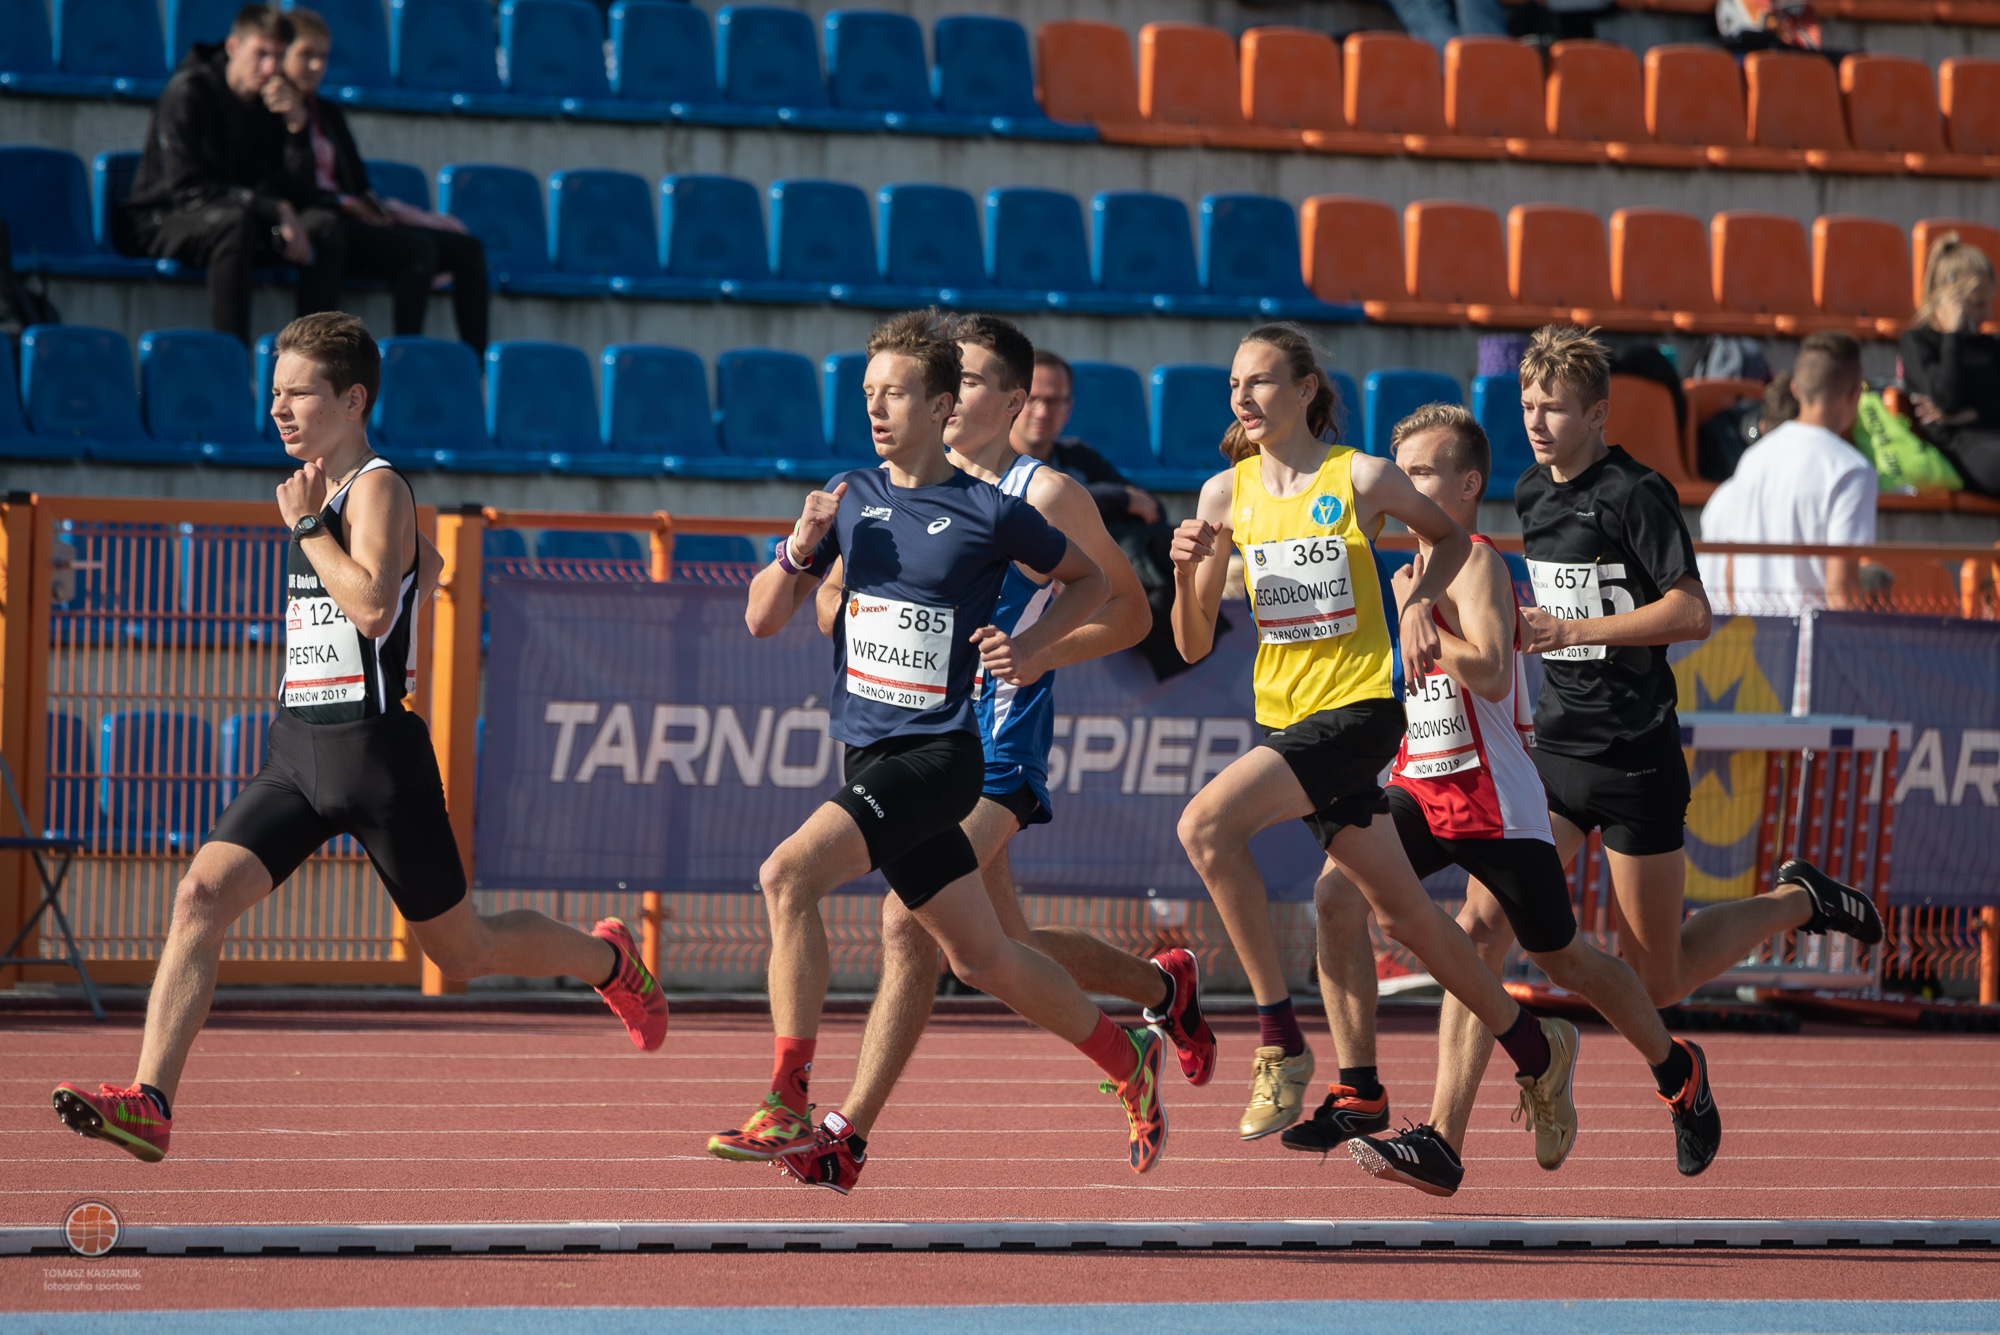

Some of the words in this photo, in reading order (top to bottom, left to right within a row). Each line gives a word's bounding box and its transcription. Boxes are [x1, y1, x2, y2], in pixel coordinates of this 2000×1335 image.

[1293, 540, 1340, 566] 365
[1554, 568, 1591, 589] 657
[309, 602, 348, 626] 124
[898, 607, 947, 634] 585
[1269, 625, 1311, 641] TARNÓW
[1313, 623, 1340, 637] 2019
[289, 644, 340, 666] PESTKA
[852, 638, 939, 671] WRZAŁEK
[1567, 647, 1590, 658] 2019
[287, 689, 319, 704] TARNÓW
[322, 688, 348, 701] 2019
[858, 683, 896, 701] TARNÓW
[898, 693, 926, 706] 2019
[1423, 678, 1457, 702] 151
[1406, 714, 1467, 740] KOŁOWSKI
[544, 693, 846, 788] TARNÓ
[1435, 758, 1460, 773] 2019
[863, 794, 885, 819] JAKO
